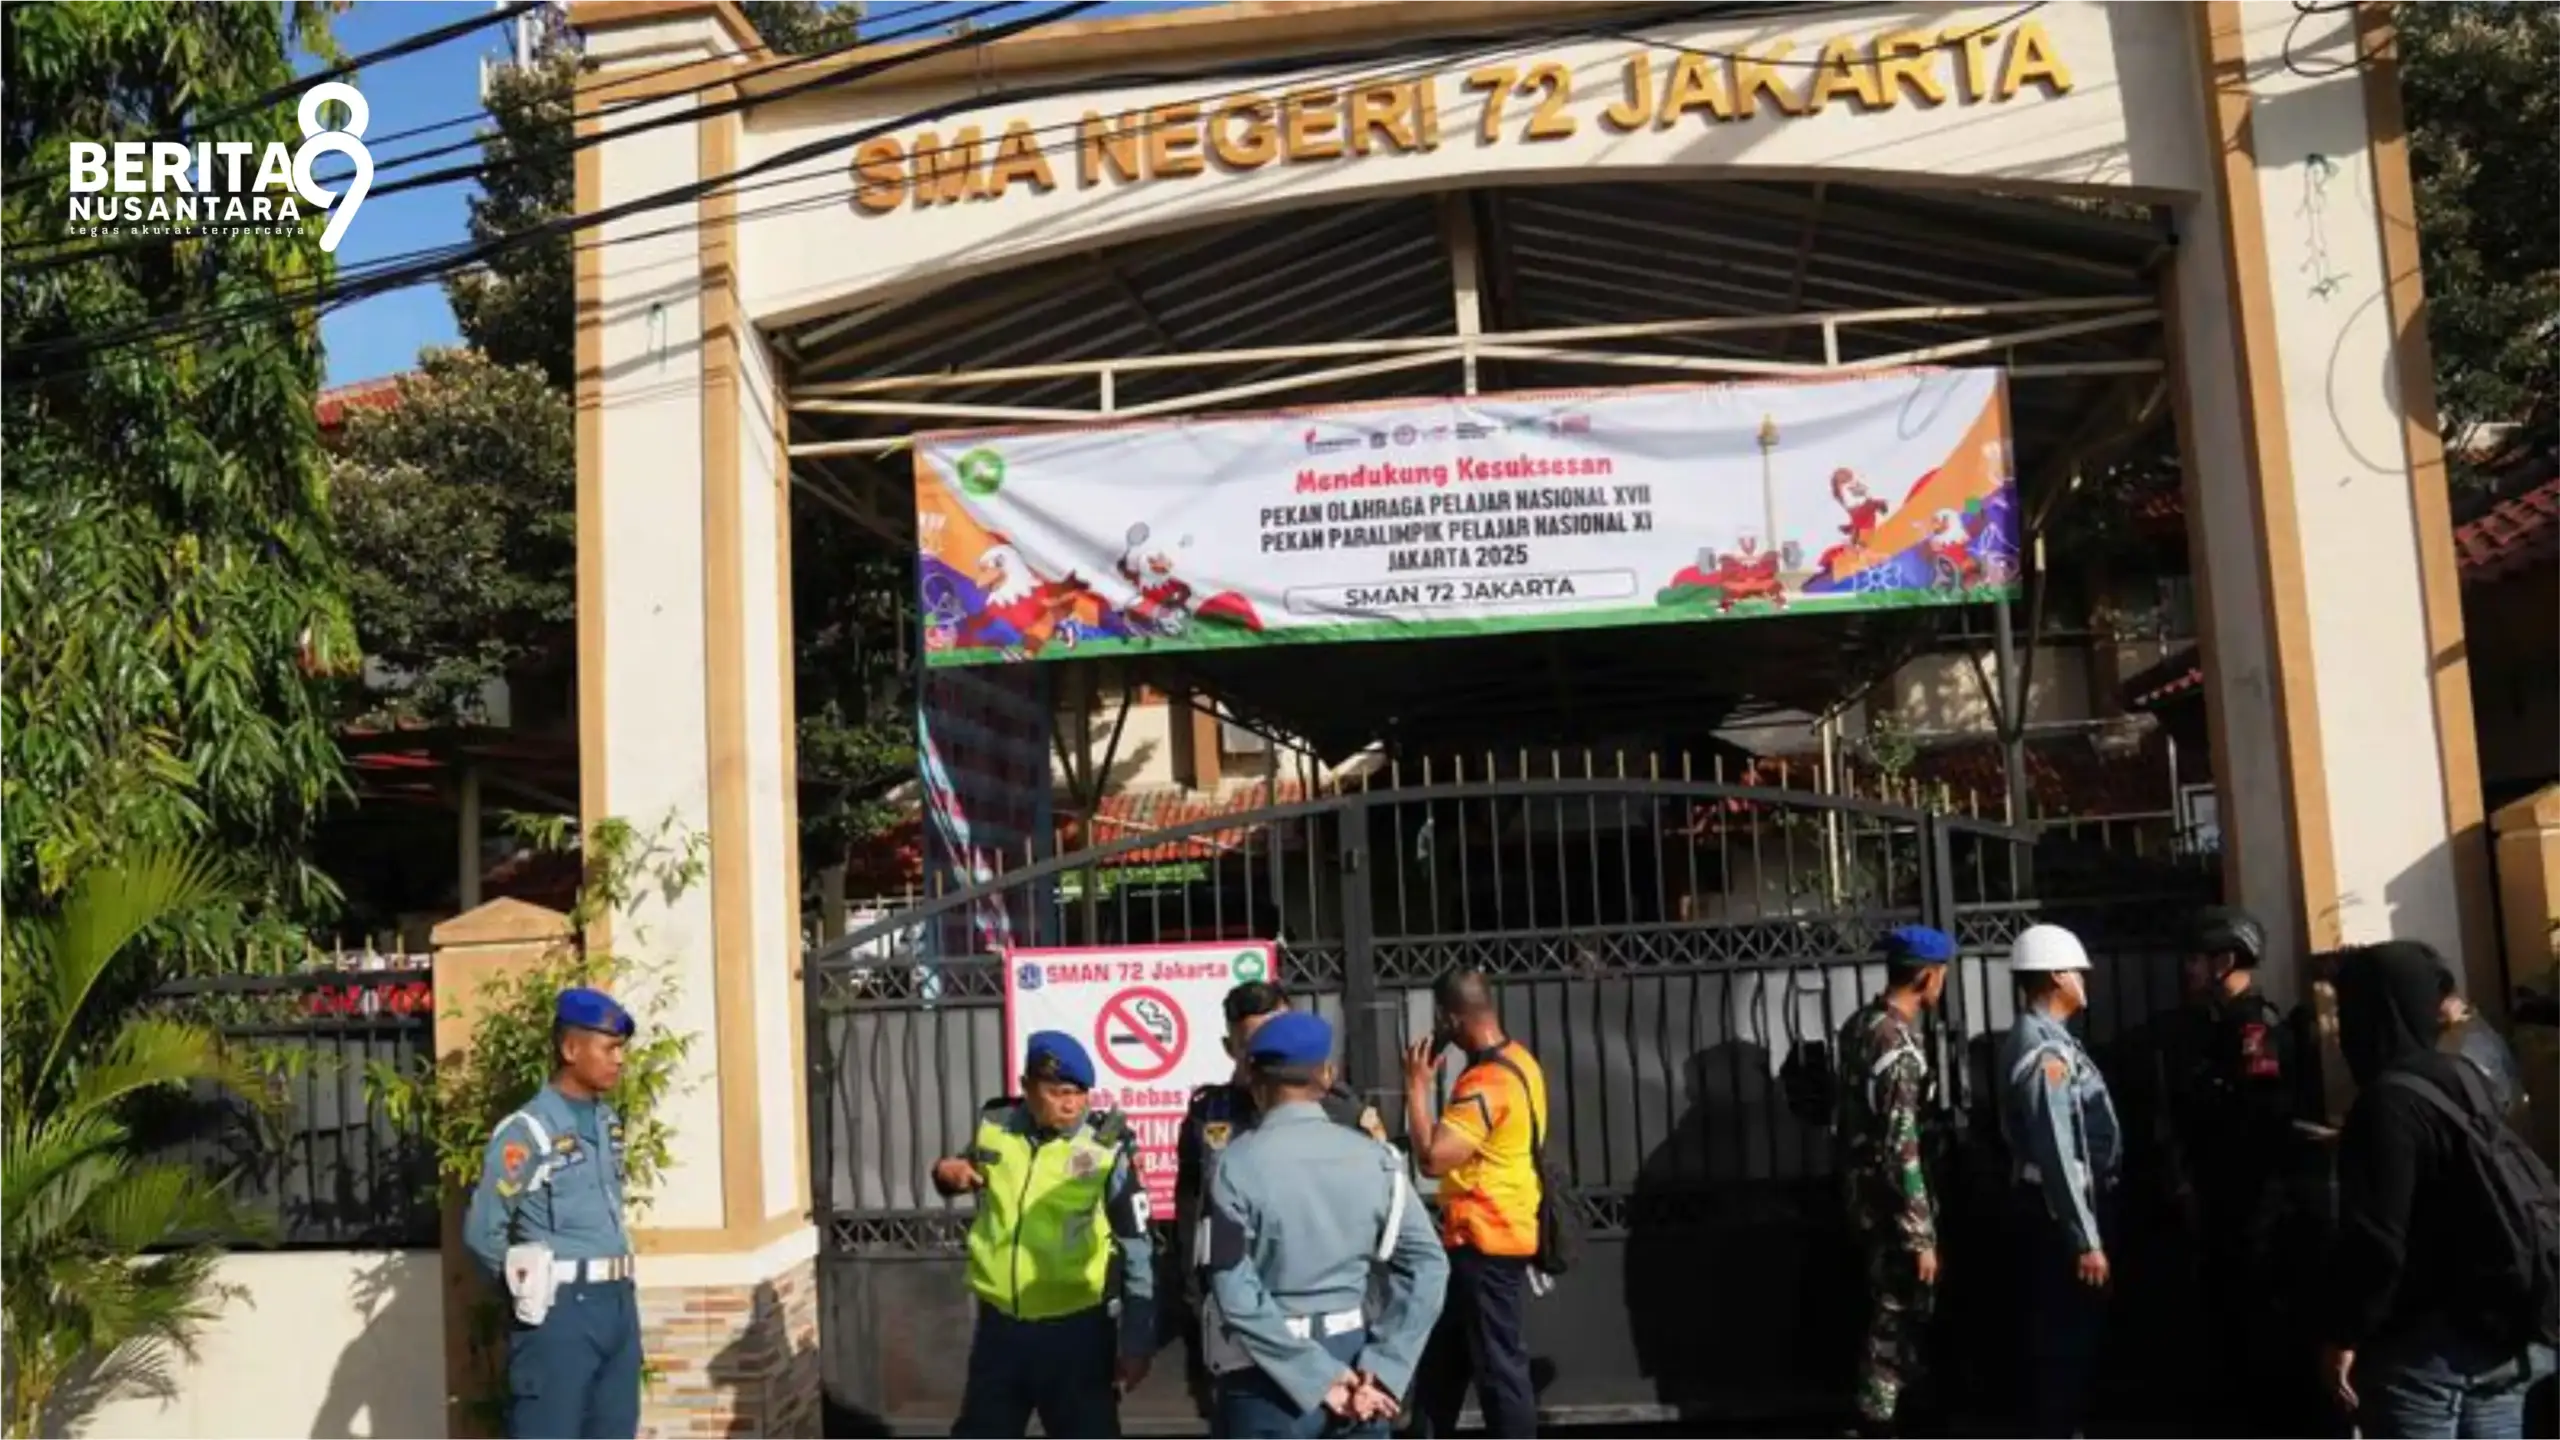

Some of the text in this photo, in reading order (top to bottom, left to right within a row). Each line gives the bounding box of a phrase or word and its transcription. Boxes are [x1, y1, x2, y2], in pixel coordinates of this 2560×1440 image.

[851, 20, 2072, 210] SMA NEGERI 72 JAKARTA
[1295, 453, 1613, 494] Mendukung Kesuksesan
[1260, 485, 1651, 528] PEKAN OLAHRAGA PELAJAR NASIONAL XVII
[1261, 511, 1652, 553] PEKAN PARALIMPIK PELAJAR NASIONAL XI
[1387, 544, 1528, 572] JAKARTA 2025
[1344, 578, 1576, 606] SMAN 72 JAKARTA
[1046, 961, 1229, 984] SMAN 72 Jakarta
